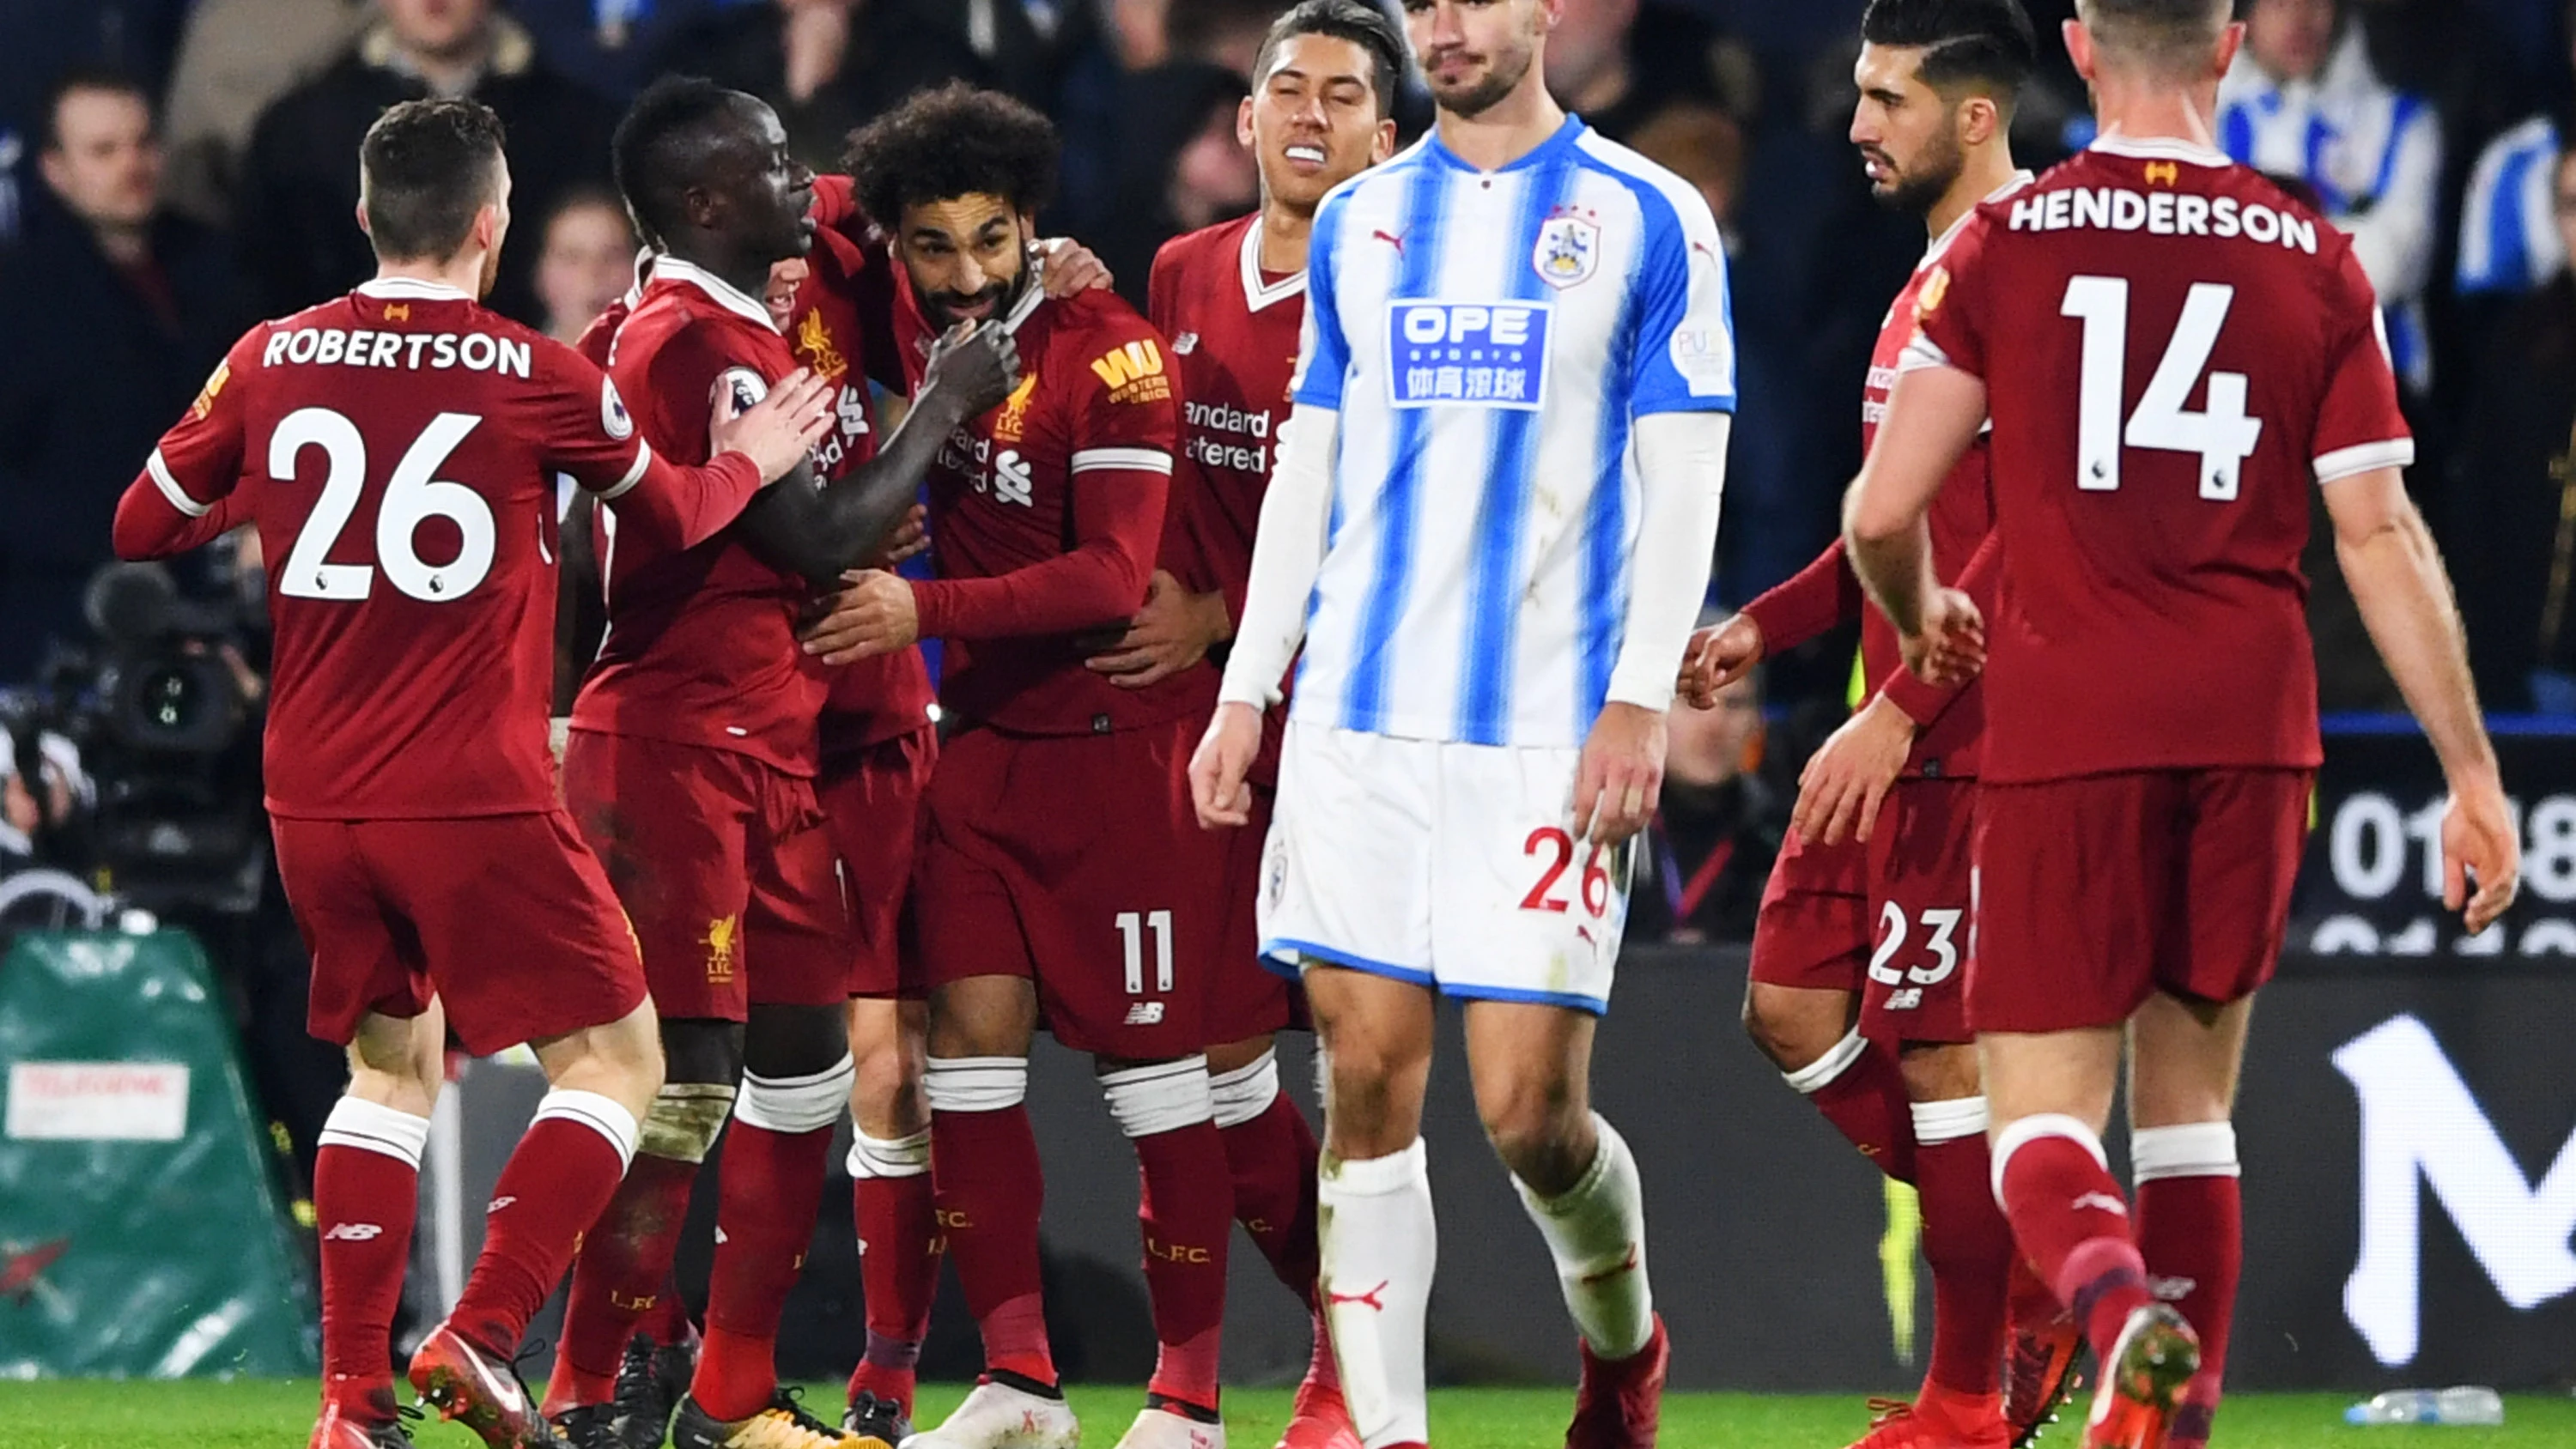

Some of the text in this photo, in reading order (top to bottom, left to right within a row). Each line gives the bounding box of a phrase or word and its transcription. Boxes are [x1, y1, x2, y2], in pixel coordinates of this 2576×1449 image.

[2009, 187, 2318, 254] HENDERSON
[263, 329, 532, 378] ROBERTSON
[1091, 338, 1163, 390] WU
[1404, 307, 1532, 345] OPE
[2060, 275, 2263, 500] 14
[269, 407, 496, 602] 26
[1519, 826, 1608, 919] 26
[2329, 791, 2576, 899] 018
[1115, 910, 1173, 994] 11
[1868, 900, 1963, 985] 23
